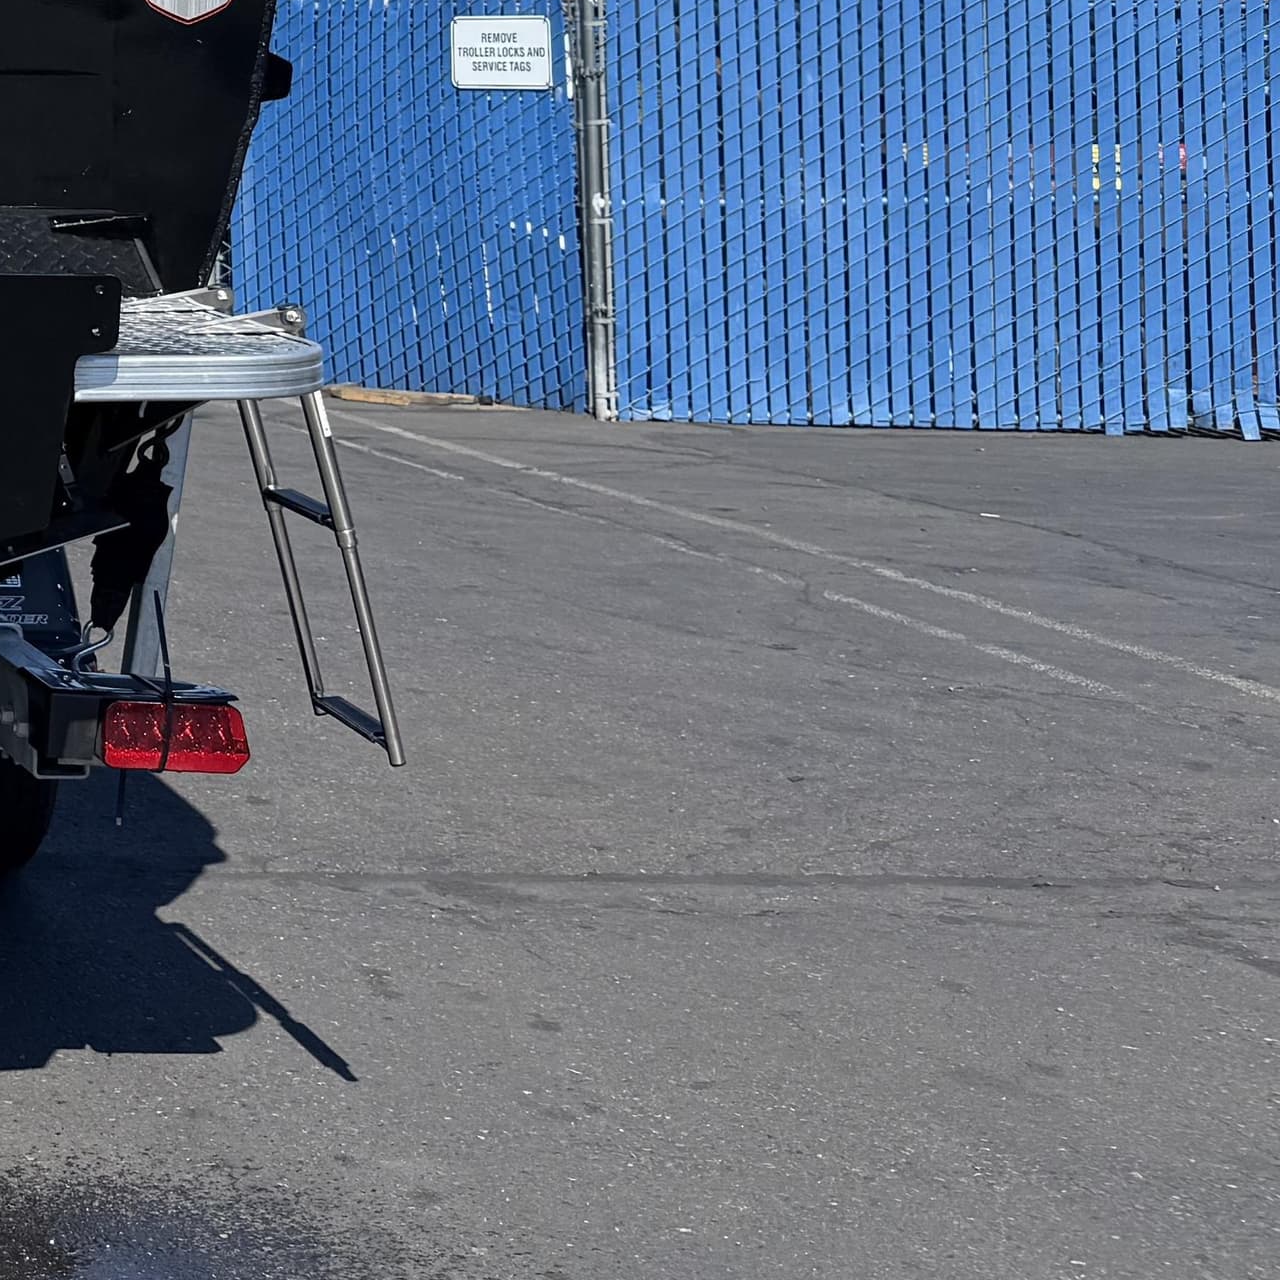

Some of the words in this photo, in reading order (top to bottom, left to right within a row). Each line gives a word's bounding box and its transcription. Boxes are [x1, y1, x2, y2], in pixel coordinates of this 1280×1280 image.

[481, 32, 518, 43] REMOVE
[458, 47, 496, 58] TROLLER
[498, 47, 525, 58] LOCKS
[527, 47, 546, 58] AND
[472, 61, 507, 72] SERVICE
[509, 61, 532, 72] TAGS
